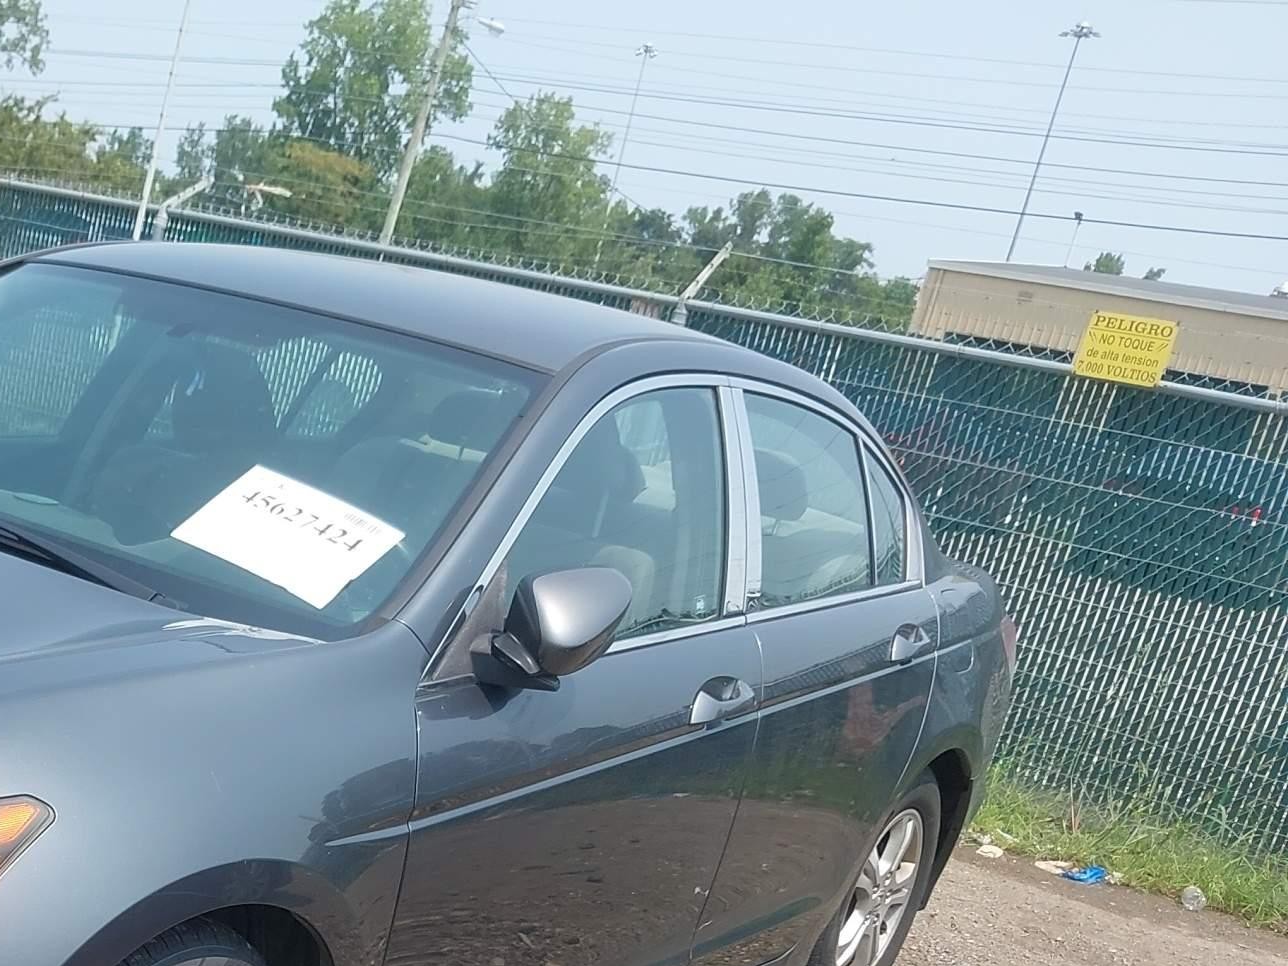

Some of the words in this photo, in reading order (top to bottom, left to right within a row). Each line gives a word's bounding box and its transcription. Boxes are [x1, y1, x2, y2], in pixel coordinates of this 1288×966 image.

[1094, 315, 1173, 339] PELIGRO
[1099, 333, 1116, 346] NO
[1118, 336, 1156, 352] TOQUE
[1086, 347, 1097, 358] de
[1100, 349, 1119, 362] alta
[1121, 352, 1159, 368] tension
[1106, 364, 1157, 384] VOLTIOS
[242, 491, 363, 552] 45627424
